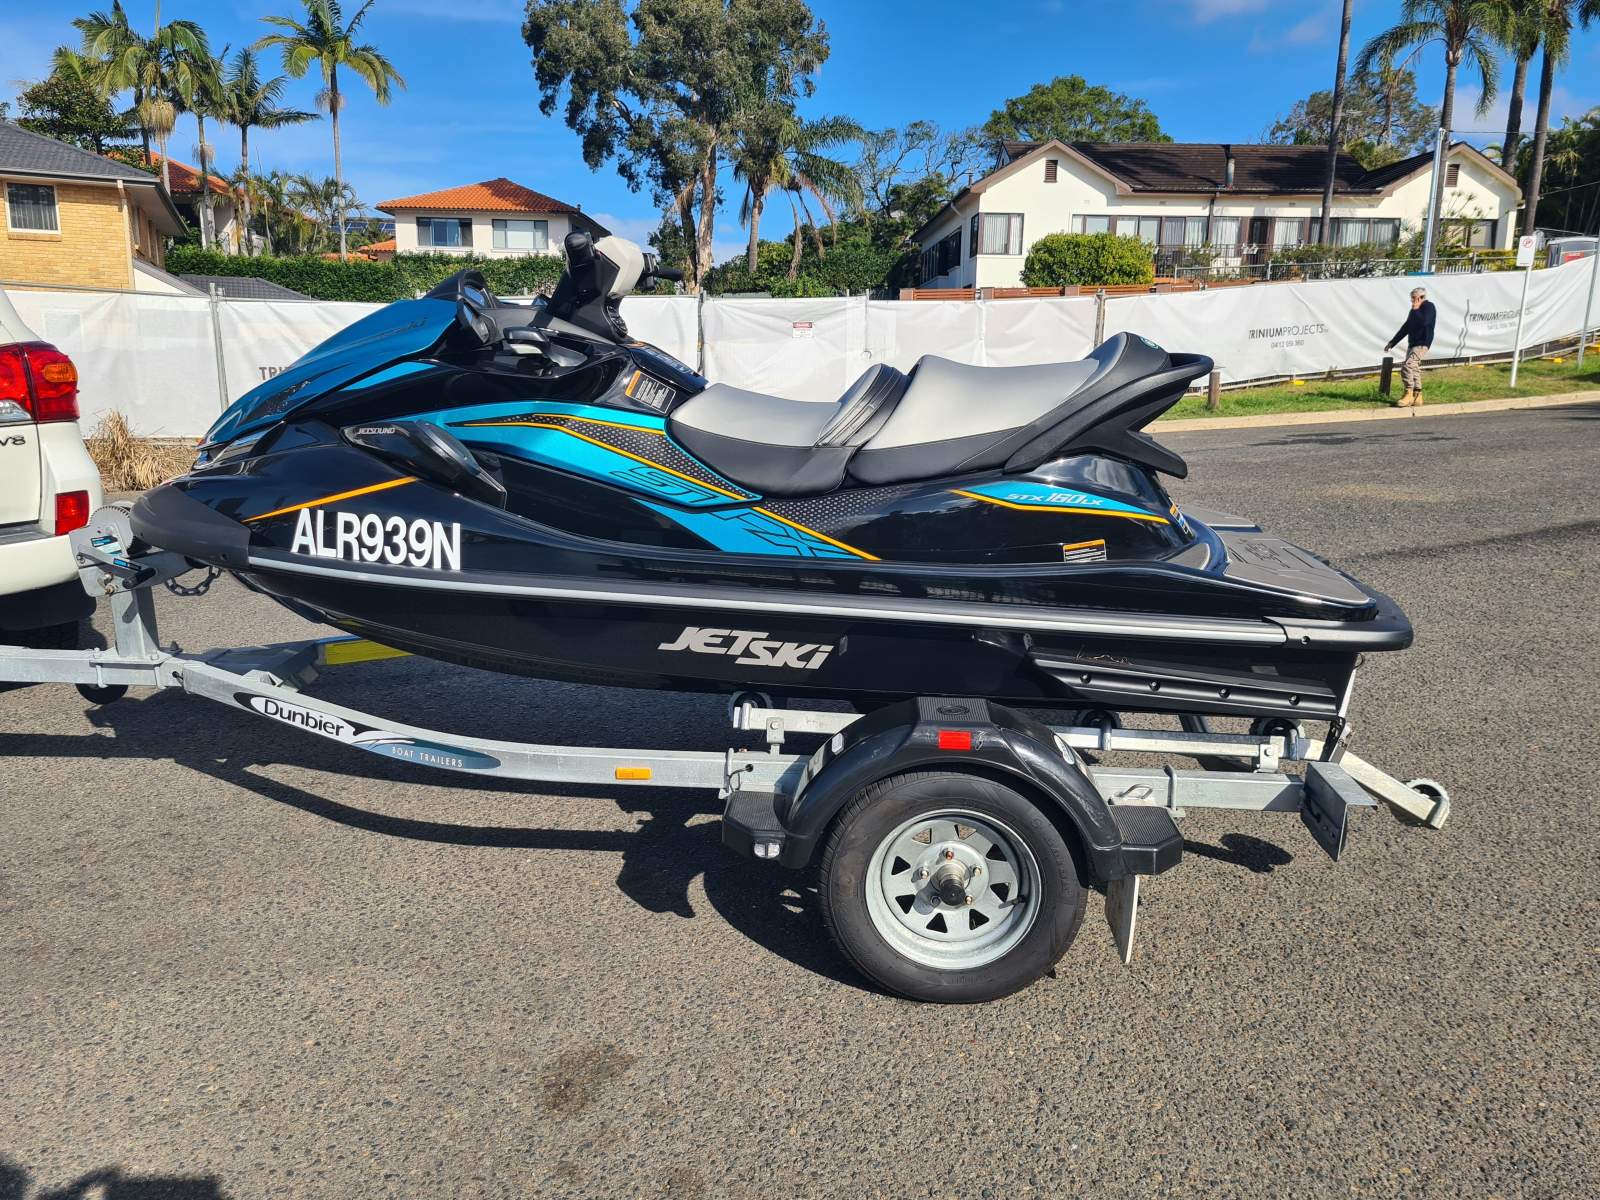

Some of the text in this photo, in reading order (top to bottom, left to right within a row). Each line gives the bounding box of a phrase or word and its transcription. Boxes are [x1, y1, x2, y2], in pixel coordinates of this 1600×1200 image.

[290, 508, 461, 571] ALR939N
[264, 699, 344, 737] Dunbier
[391, 746, 463, 768] BOAT TRAILERS
